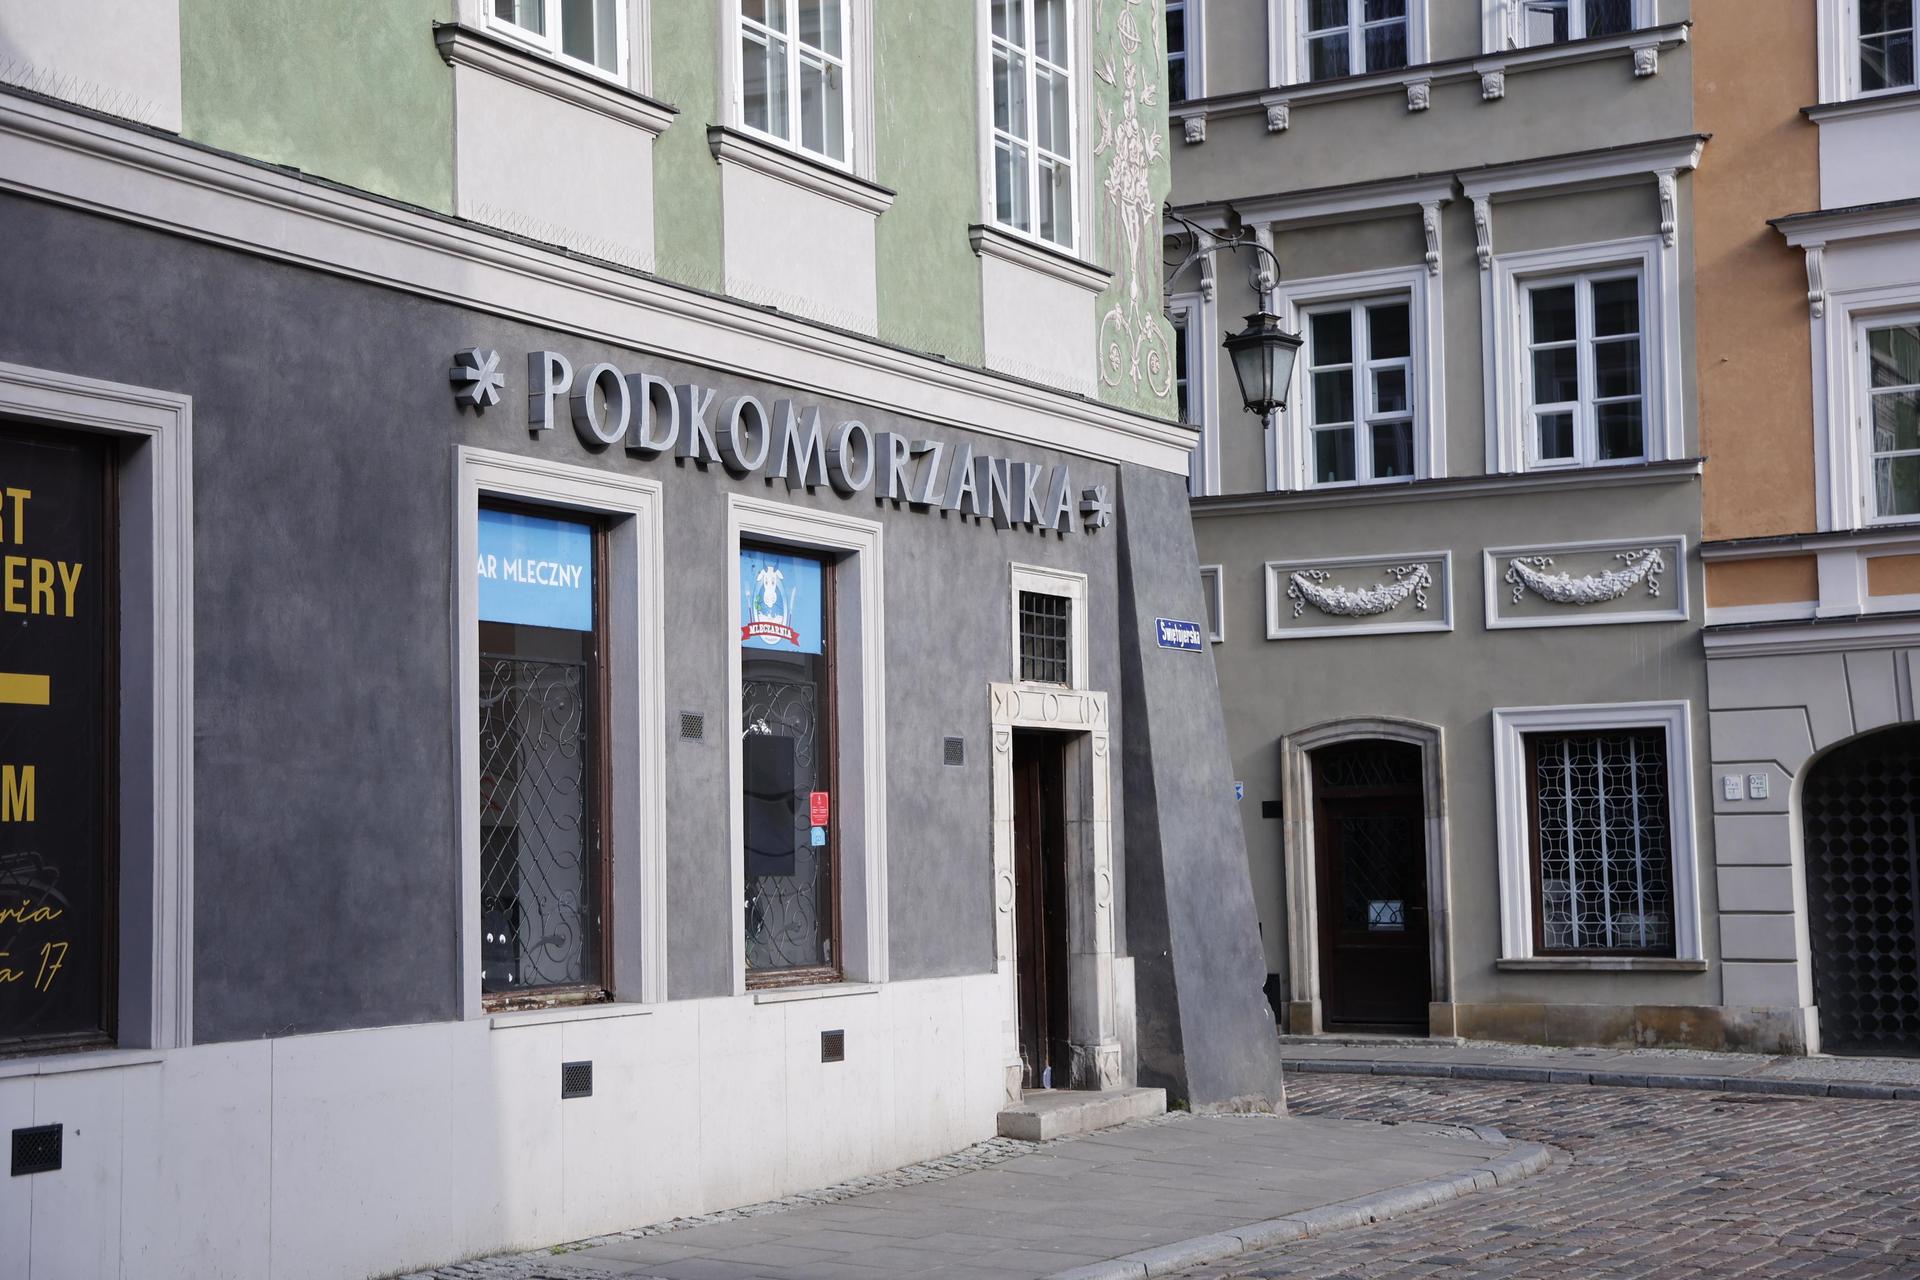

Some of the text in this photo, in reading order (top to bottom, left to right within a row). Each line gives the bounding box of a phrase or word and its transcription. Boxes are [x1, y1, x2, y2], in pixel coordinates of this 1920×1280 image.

[529, 351, 1075, 533] PODKOMORZANKA
[0, 487, 32, 545] T
[5, 555, 83, 618] ERY
[503, 557, 583, 589] MLECZNY
[749, 623, 793, 639] MLECZARNIA
[35, 942, 68, 992] 17
